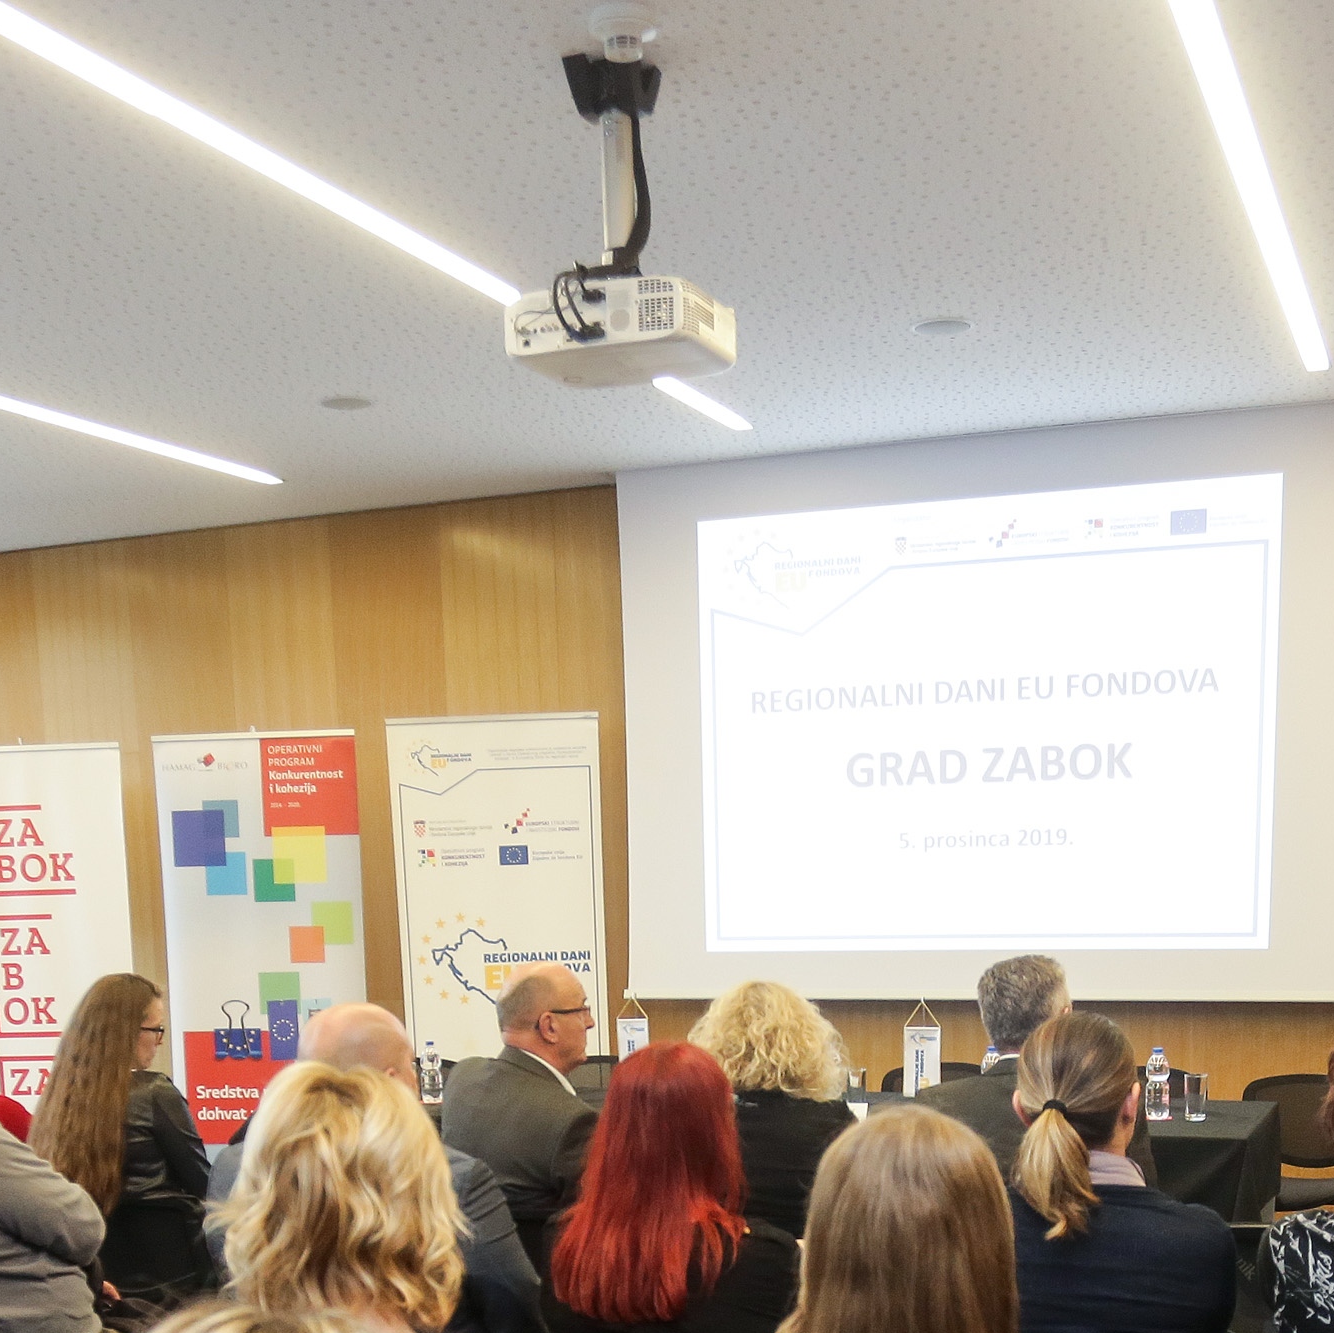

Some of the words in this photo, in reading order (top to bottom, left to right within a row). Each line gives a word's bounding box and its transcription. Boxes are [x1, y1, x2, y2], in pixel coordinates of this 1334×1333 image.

[774, 557, 834, 571] REGIONALNI
[836, 555, 861, 566] DANI
[775, 571, 808, 593] EU
[808, 566, 861, 578] FONDOVA
[750, 682, 924, 715] REGIONALNI
[933, 677, 1006, 706] DANI
[1016, 674, 1054, 702] EU
[1065, 666, 1220, 698] FONDOVA
[267, 744, 323, 754] OPERATIVNI
[268, 757, 315, 767] PROGRAM
[845, 749, 969, 789] GRAD
[981, 742, 1134, 784] ZABOK
[269, 769, 344, 781] Konkurentnost
[275, 783, 317, 796] kohezija
[898, 832, 916, 851] 5.
[923, 829, 1010, 853] prosinca
[1016, 827, 1074, 848] 2019.
[0, 927, 51, 956] ZA
[483, 951, 558, 963] REGIONALNI
[560, 950, 591, 961] DANI
[1, 963, 24, 991] B
[3, 996, 58, 1025] OK
[195, 1084, 260, 1099] Sredstva
[197, 1106, 248, 1120] dohvat
